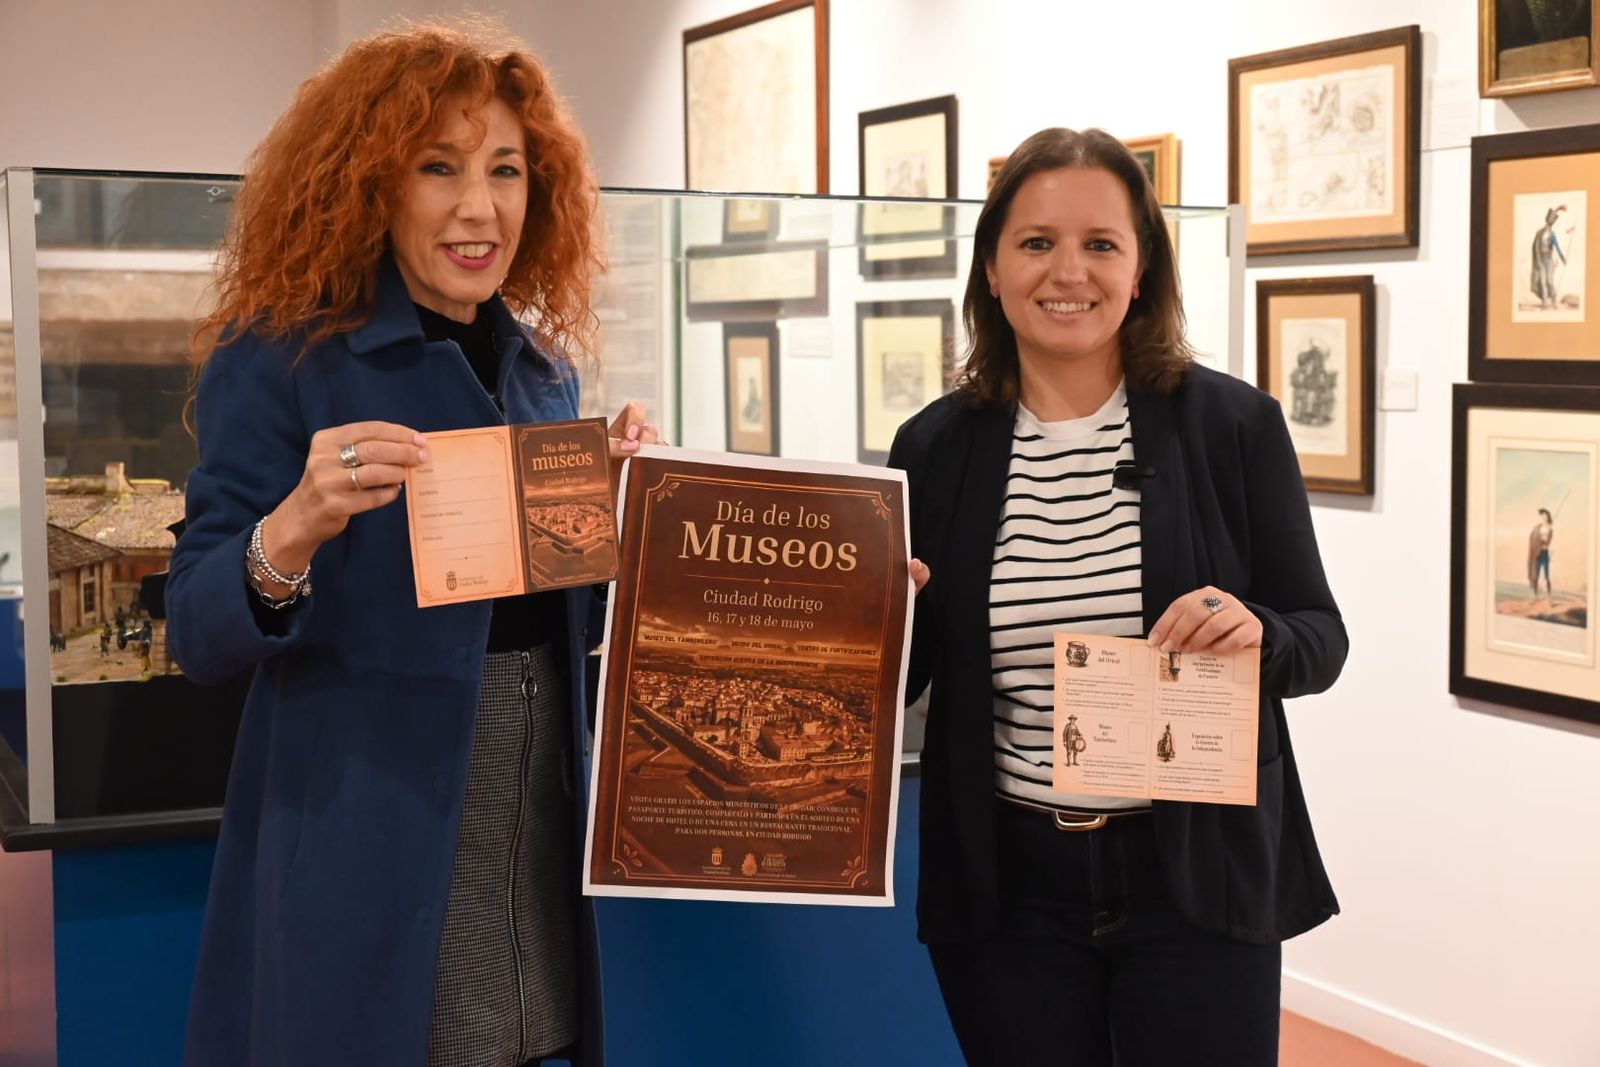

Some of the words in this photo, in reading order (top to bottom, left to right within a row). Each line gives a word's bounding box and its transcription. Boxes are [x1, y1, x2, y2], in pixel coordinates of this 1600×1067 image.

[543, 443, 556, 453] Día
[558, 442, 567, 452] de
[569, 441, 581, 451] los
[532, 452, 593, 471] museos
[715, 500, 755, 524] Día
[762, 503, 790, 527] de
[796, 506, 831, 530] los
[678, 520, 858, 572] Museos
[703, 589, 759, 607] Ciudad
[762, 593, 823, 614] Rodrigo
[708, 611, 723, 625] 16,
[726, 612, 738, 624] 17
[739, 615, 747, 627] y
[749, 614, 762, 626] 18
[763, 615, 778, 627] de
[781, 618, 814, 632] mayo
